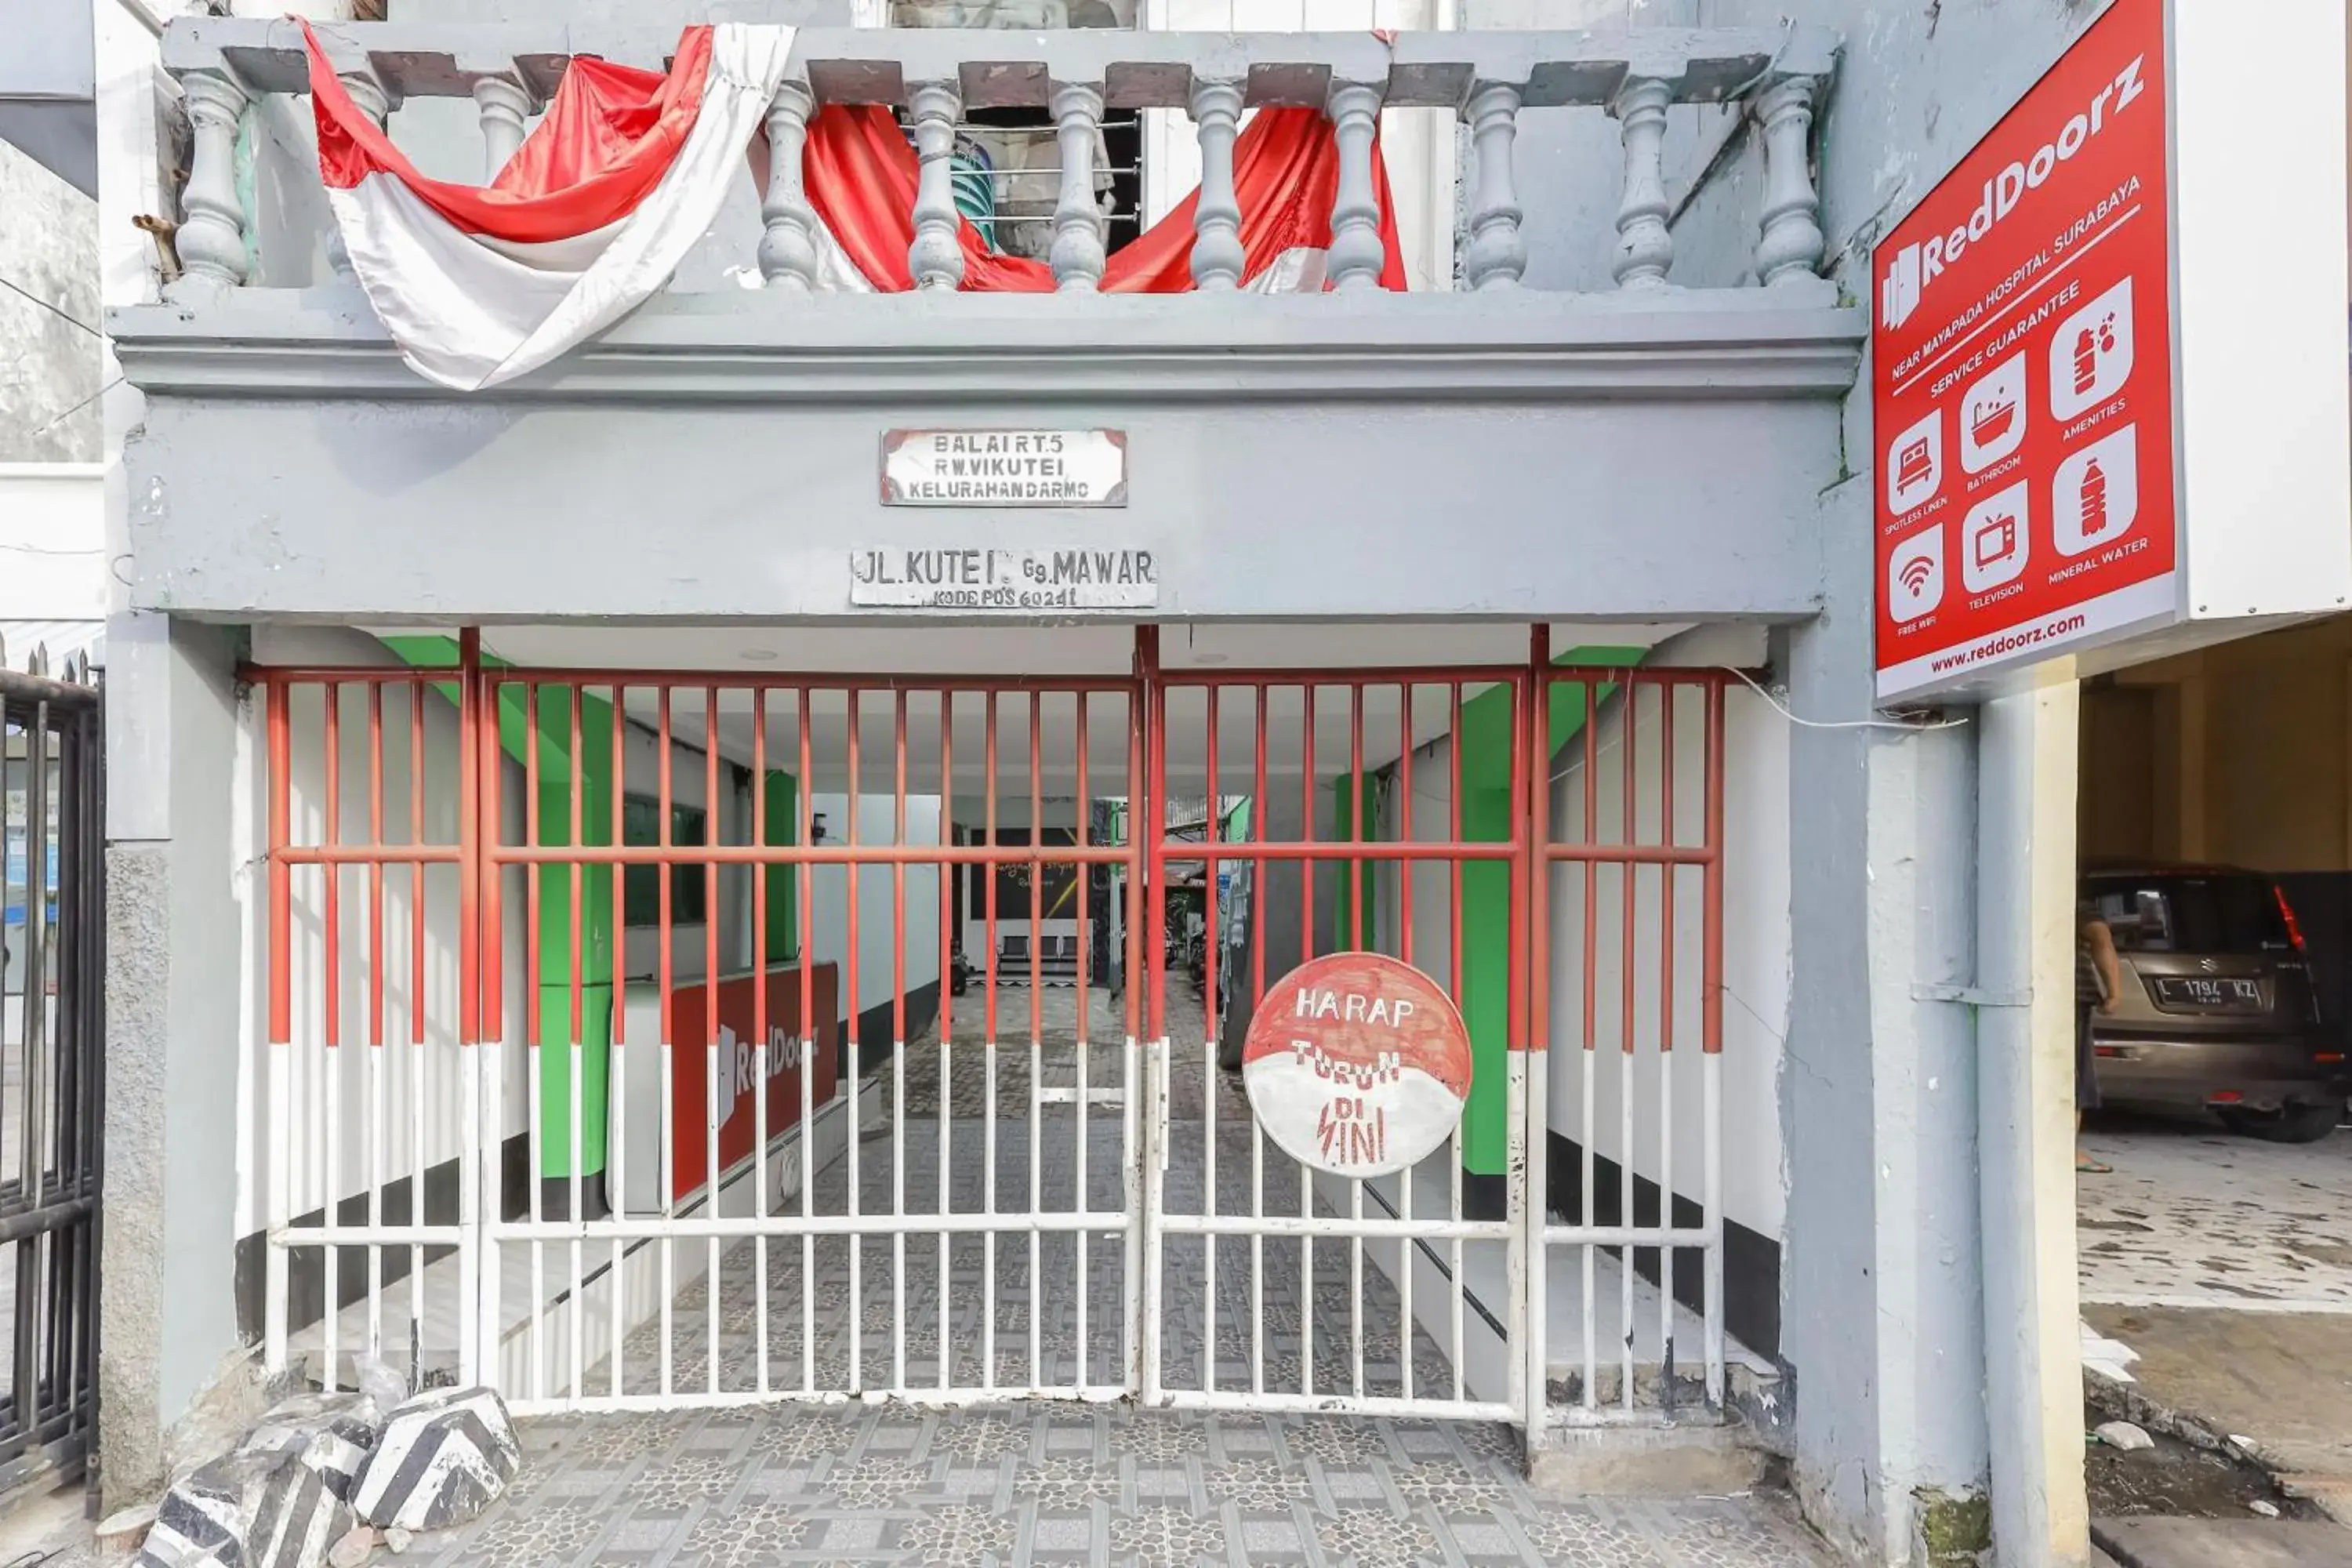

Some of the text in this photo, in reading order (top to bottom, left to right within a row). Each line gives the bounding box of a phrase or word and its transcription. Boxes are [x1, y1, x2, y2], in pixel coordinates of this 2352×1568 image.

[1922, 53, 2145, 288] RedDoorz
[1892, 175, 2140, 381] NEAR MAYAPADA HOSPITAL SURABAYA
[1931, 279, 2080, 398] SERVICE GUARANTEE
[2062, 397, 2126, 442] AMENITIES
[1966, 455, 2022, 492] BATHROOM
[1885, 495, 1948, 535] SPOTLESS LINEN
[2048, 537, 2148, 585] MINERAL WATER
[1969, 583, 2024, 610] TELEVISION
[1897, 622, 1918, 637] FREE
[1931, 612, 2085, 673] www.reddoorz.com
[1295, 987, 1414, 1028] HARAP
[1291, 1040, 1401, 1091] TURUN
[1335, 1097, 1363, 1120] DI
[1316, 1101, 1385, 1165] SINI
